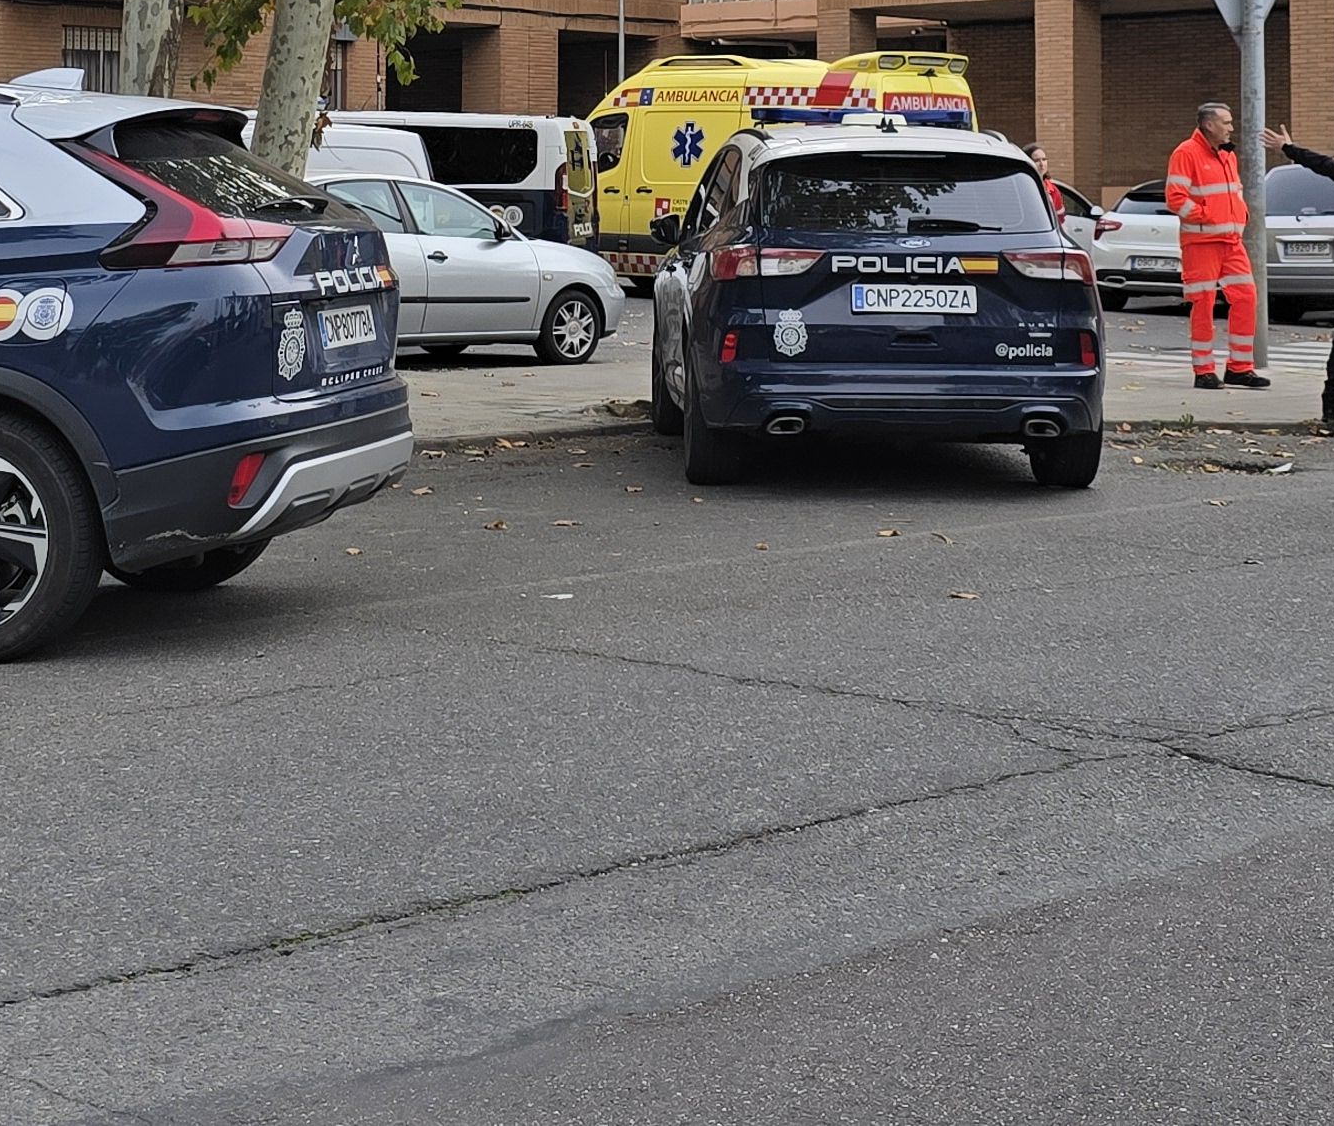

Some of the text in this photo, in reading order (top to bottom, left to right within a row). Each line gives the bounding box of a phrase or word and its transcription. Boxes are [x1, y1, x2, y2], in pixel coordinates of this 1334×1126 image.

[655, 89, 740, 104] AMBULANCIA
[890, 94, 969, 112] AMBULANCIA
[831, 256, 966, 274] POLICIA
[865, 288, 971, 309] CNP2250ZA
[995, 343, 1054, 360] @policia
